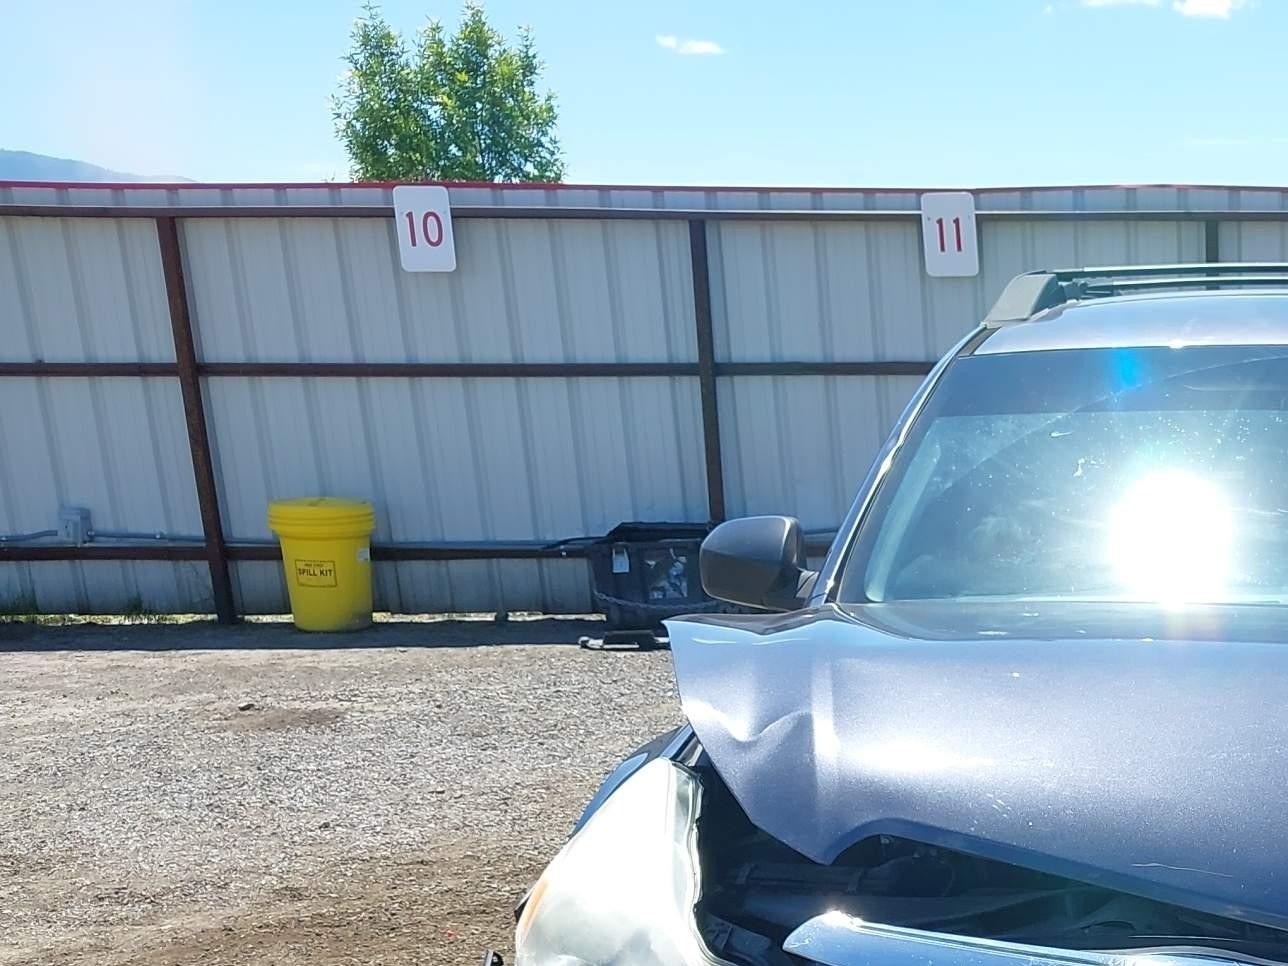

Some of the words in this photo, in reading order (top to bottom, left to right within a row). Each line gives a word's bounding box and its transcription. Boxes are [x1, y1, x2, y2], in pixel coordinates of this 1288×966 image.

[404, 211, 444, 248] 10
[935, 217, 963, 253] 11
[298, 568, 317, 577] SPILL
[320, 569, 333, 577] KIT
